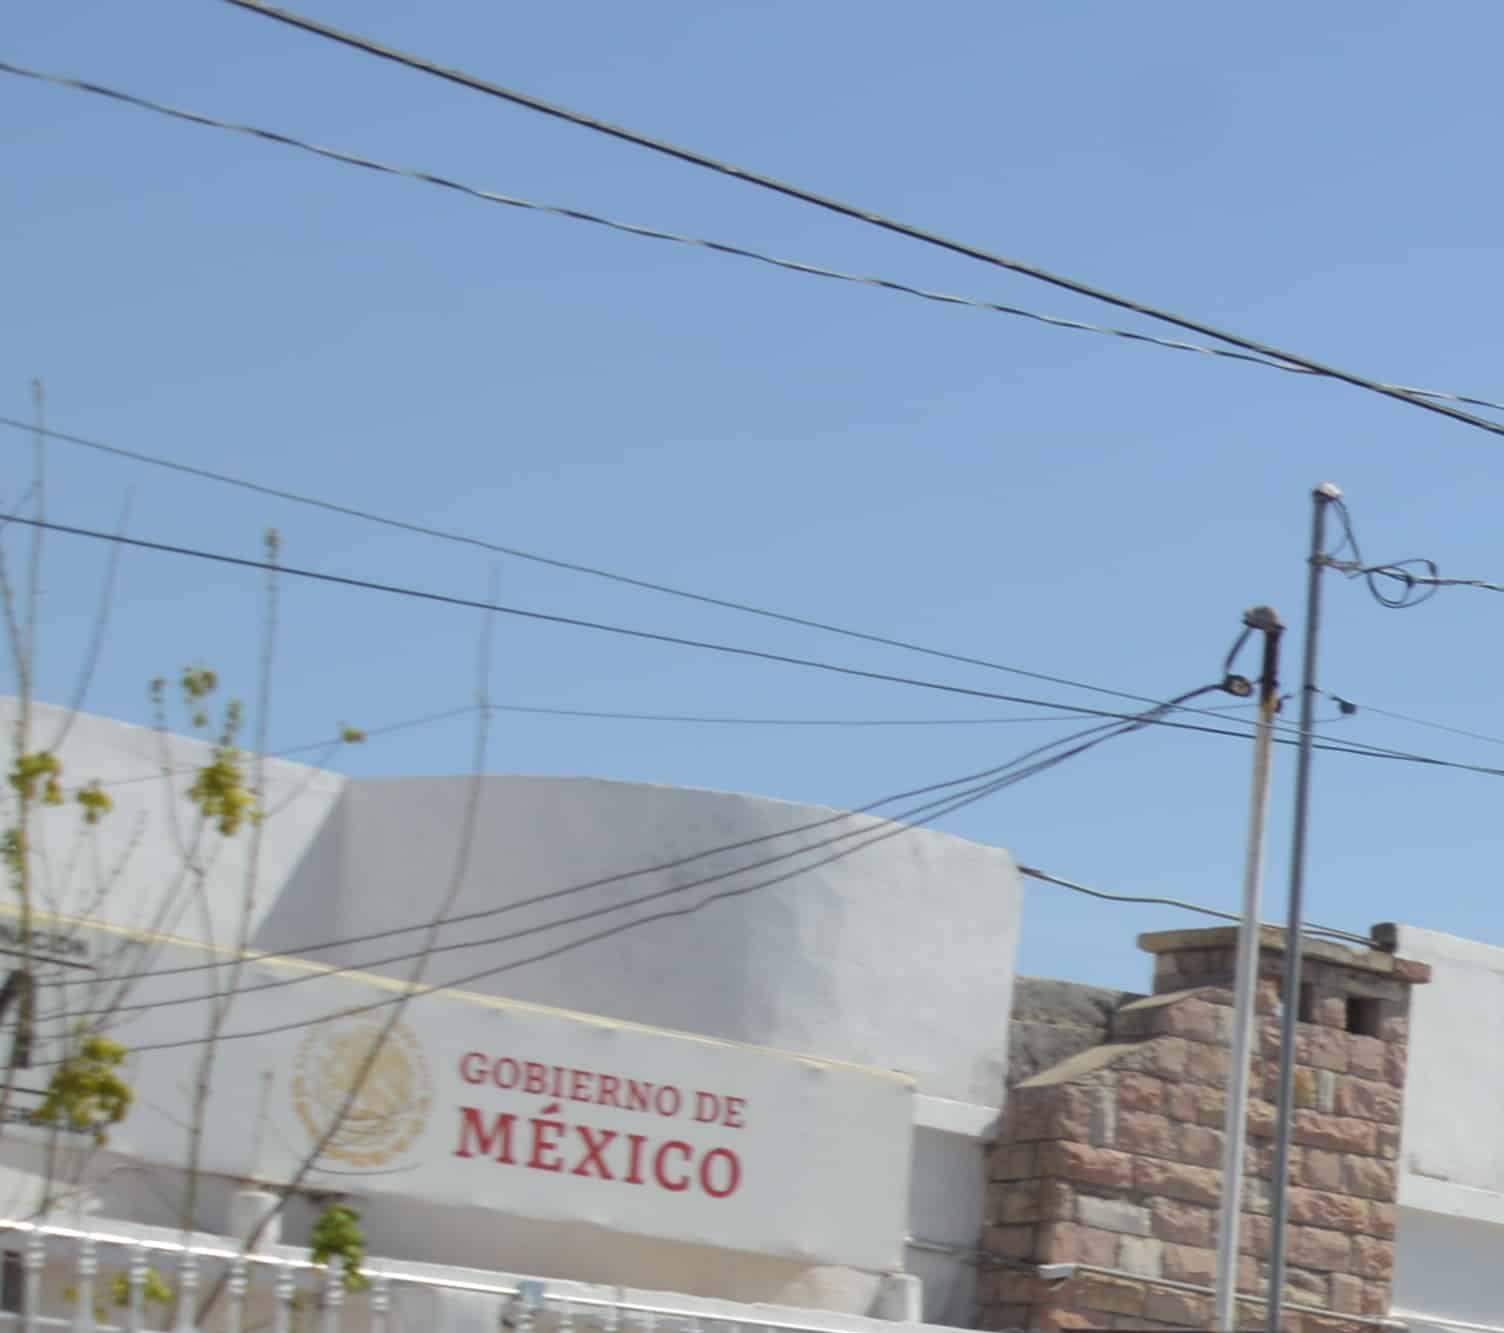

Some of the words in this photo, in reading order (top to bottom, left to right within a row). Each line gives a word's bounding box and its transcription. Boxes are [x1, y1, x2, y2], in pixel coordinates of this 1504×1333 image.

[458, 1051, 684, 1118] GOBIERNO
[691, 1090, 747, 1129] DE
[453, 1102, 743, 1199] MÉXICO
